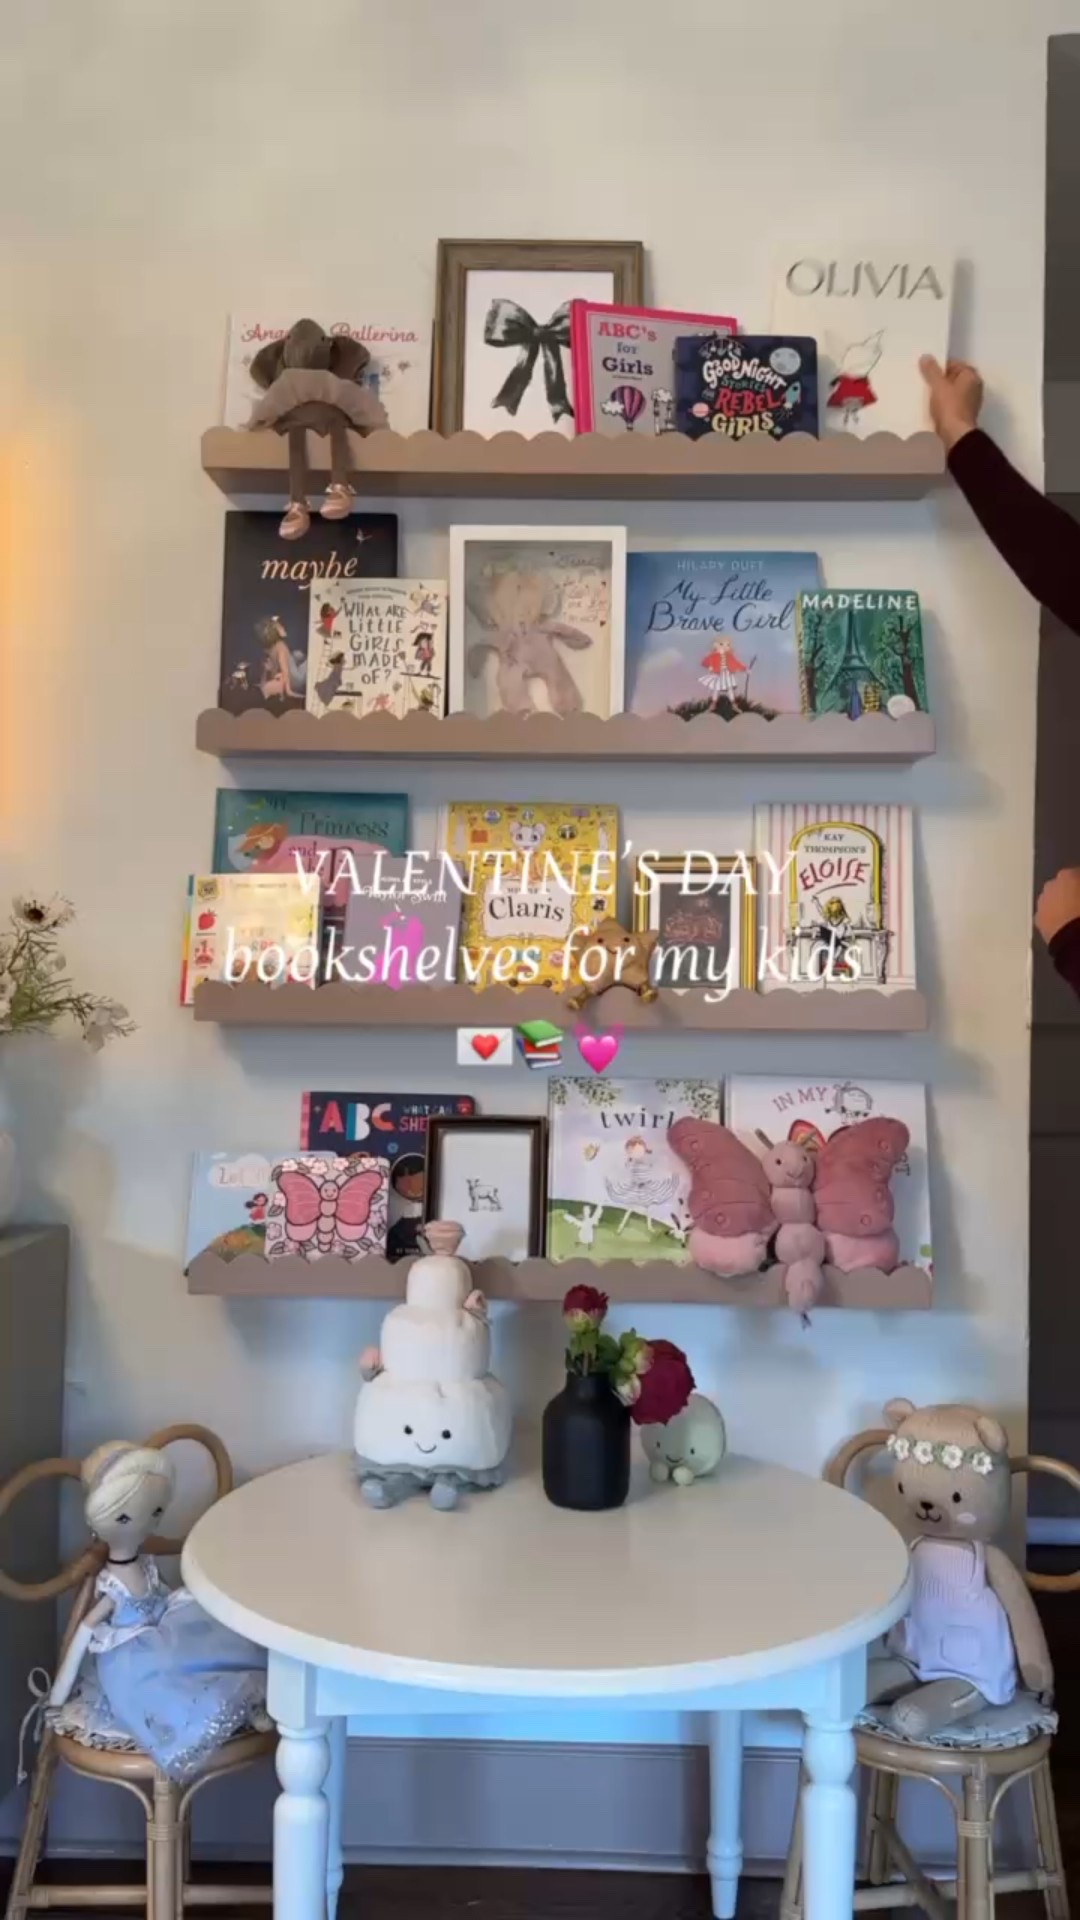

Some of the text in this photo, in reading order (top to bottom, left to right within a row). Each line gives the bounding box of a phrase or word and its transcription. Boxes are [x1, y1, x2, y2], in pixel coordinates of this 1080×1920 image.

[786, 259, 943, 300] OLIVIA
[330, 322, 418, 342] Ballerina
[598, 322, 657, 342] ABC's
[617, 342, 637, 354] for
[602, 356, 653, 375] Girls
[715, 388, 780, 416] REBEL
[261, 551, 358, 590] maybe
[677, 560, 726, 571] HILARY
[664, 574, 774, 614] My Little
[801, 593, 918, 612] MADELINE
[647, 599, 796, 633] Brave Girl
[300, 811, 390, 838] Princess
[804, 845, 867, 854] THOMPSON'S
[824, 833, 845, 842] KAY
[799, 857, 870, 891] ELOISE
[489, 896, 565, 922] Claris
[772, 1086, 827, 1112] IN MY
[319, 1100, 395, 1141] ABC
[399, 1116, 427, 1132] SHE
[600, 1107, 676, 1129] twirl
